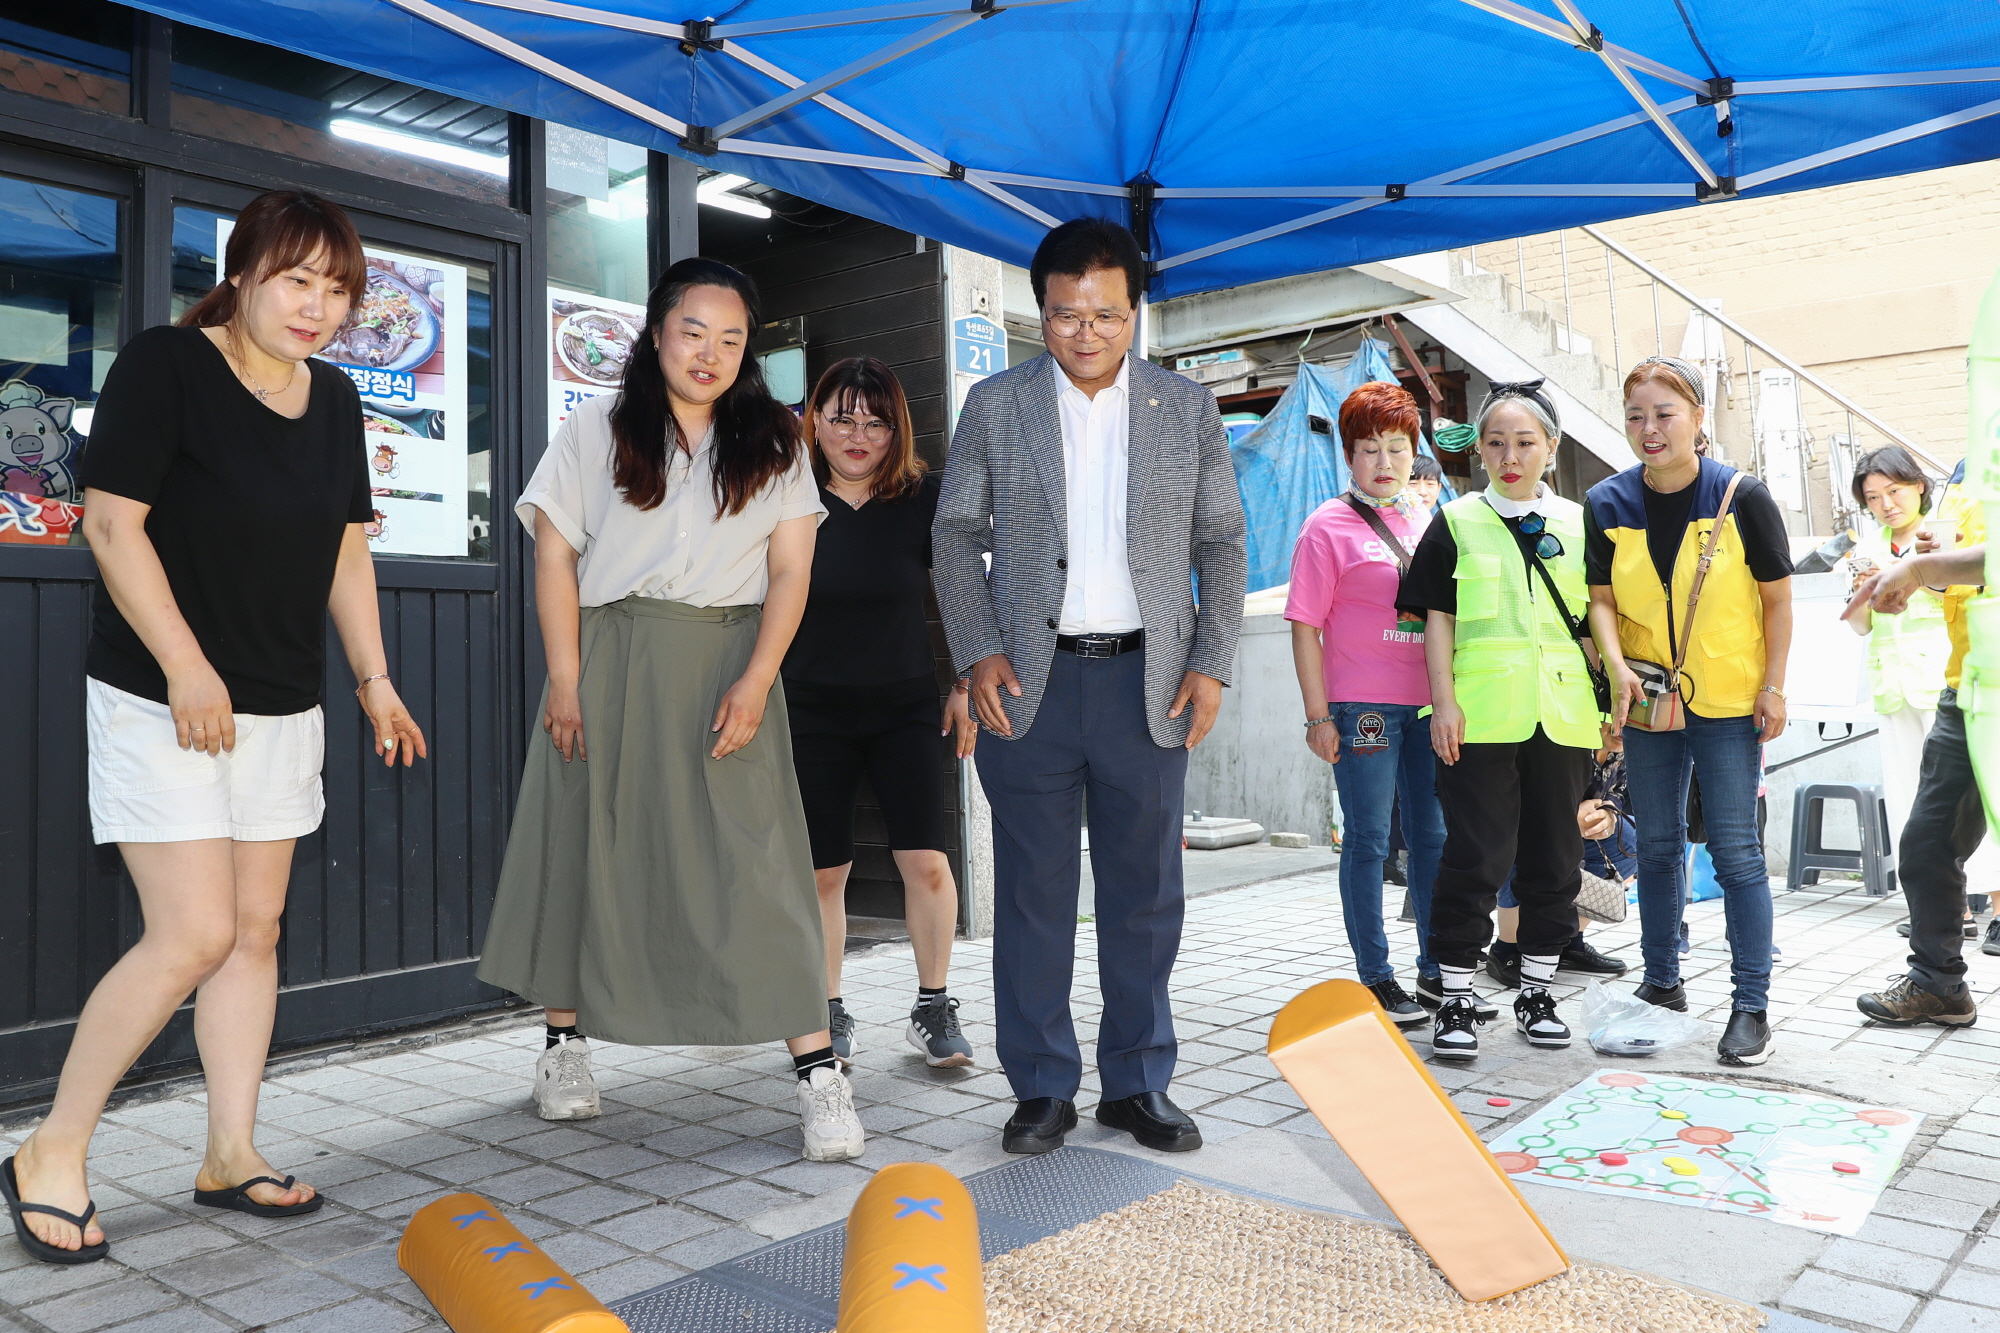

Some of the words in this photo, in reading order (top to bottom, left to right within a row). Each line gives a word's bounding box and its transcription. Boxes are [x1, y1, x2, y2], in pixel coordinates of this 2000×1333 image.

[969, 345, 992, 372] 21
[564, 390, 600, 411] 간
[1382, 629, 1411, 643] EVERY
